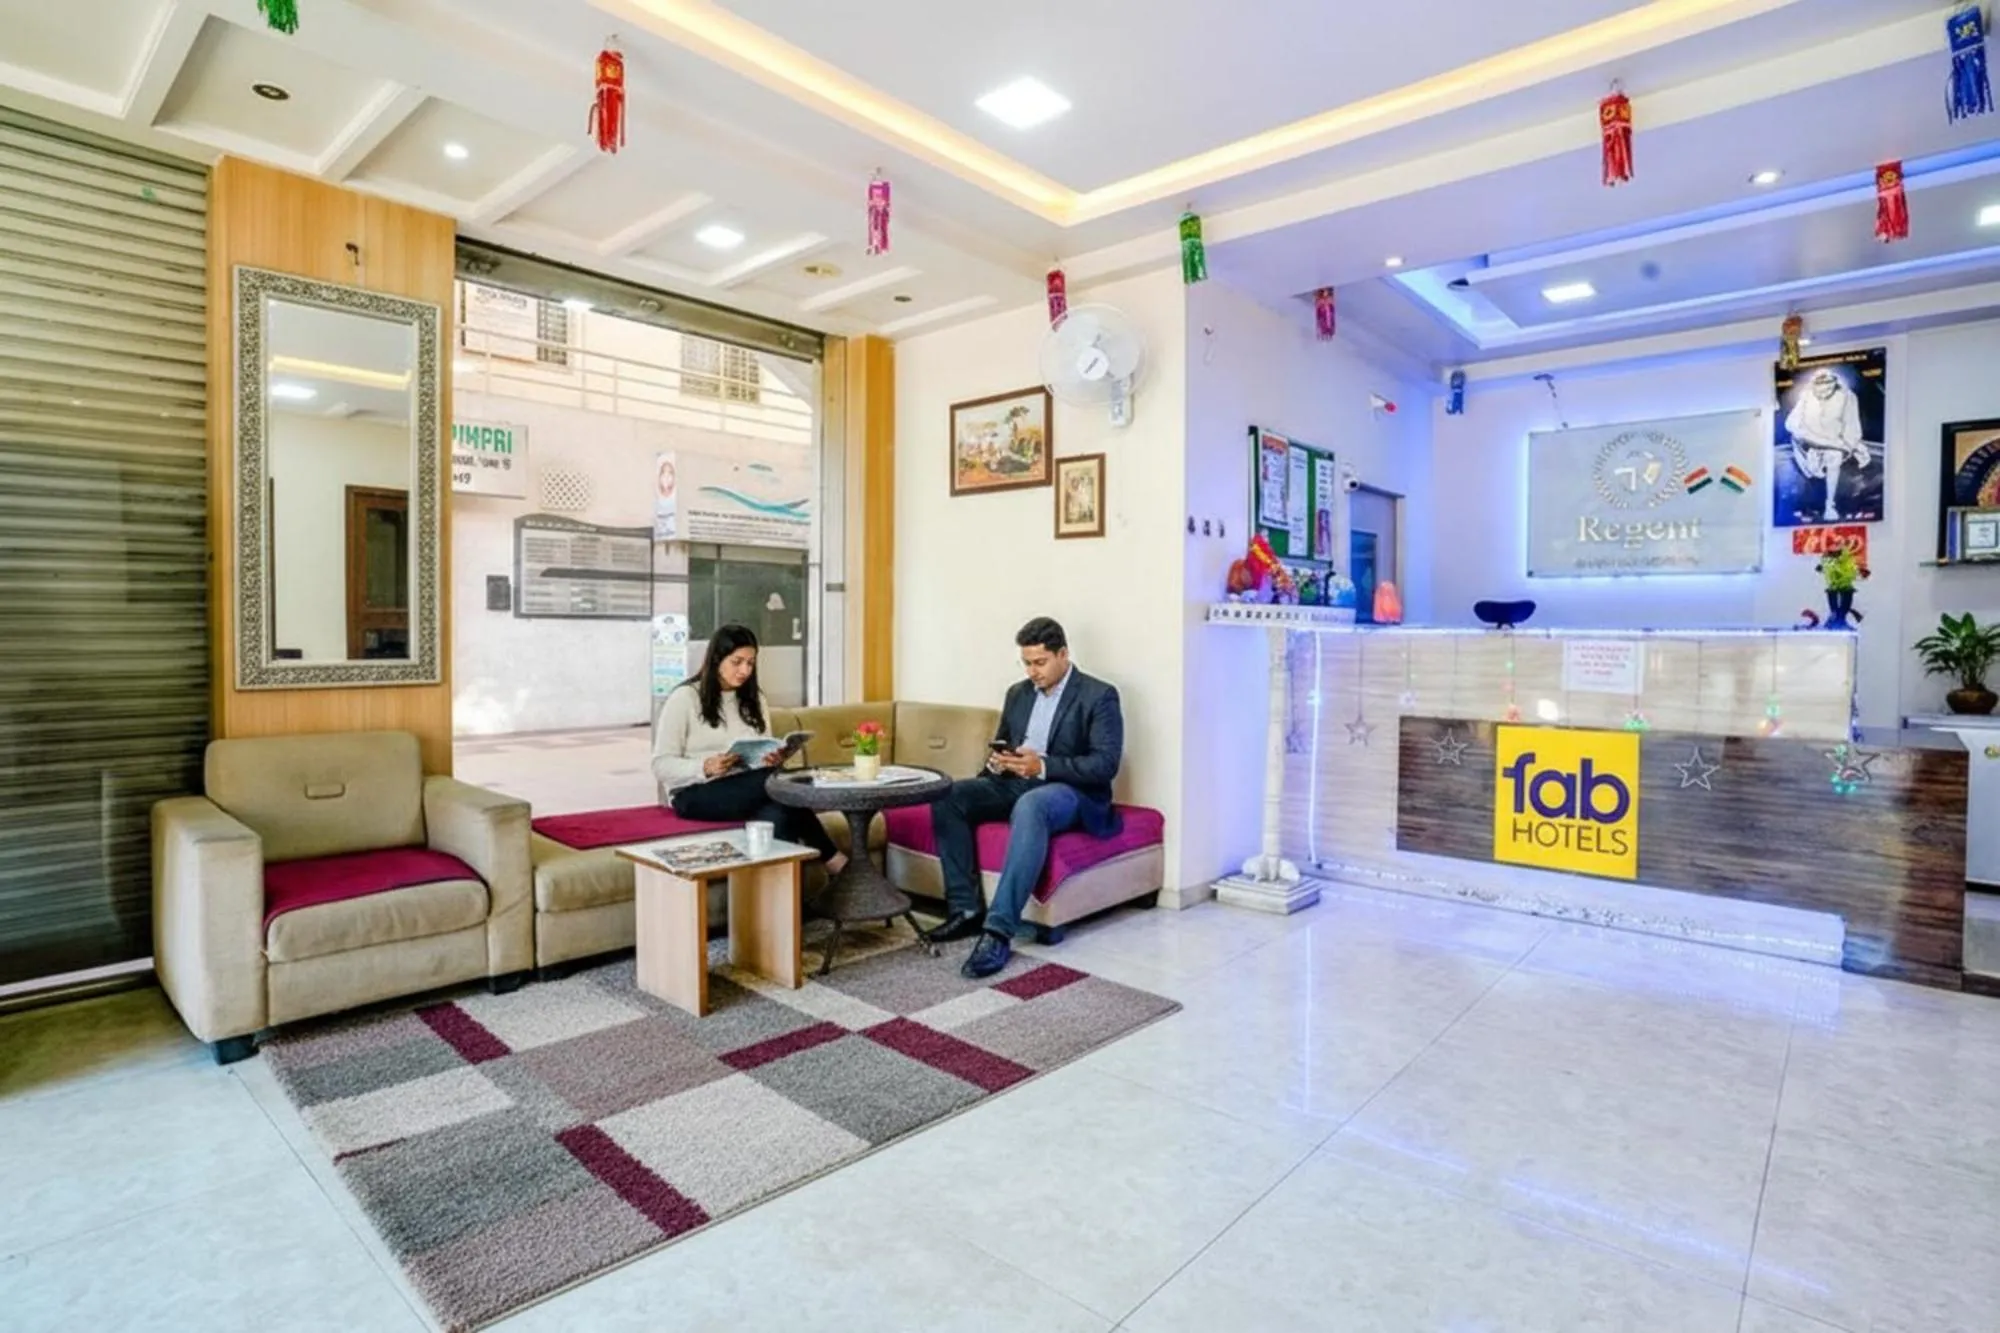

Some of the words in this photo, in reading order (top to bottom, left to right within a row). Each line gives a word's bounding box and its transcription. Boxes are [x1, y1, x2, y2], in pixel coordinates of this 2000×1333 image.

[1578, 515, 1702, 548] Regent
[1502, 751, 1632, 824] fab
[1512, 818, 1629, 856] HOTELS
